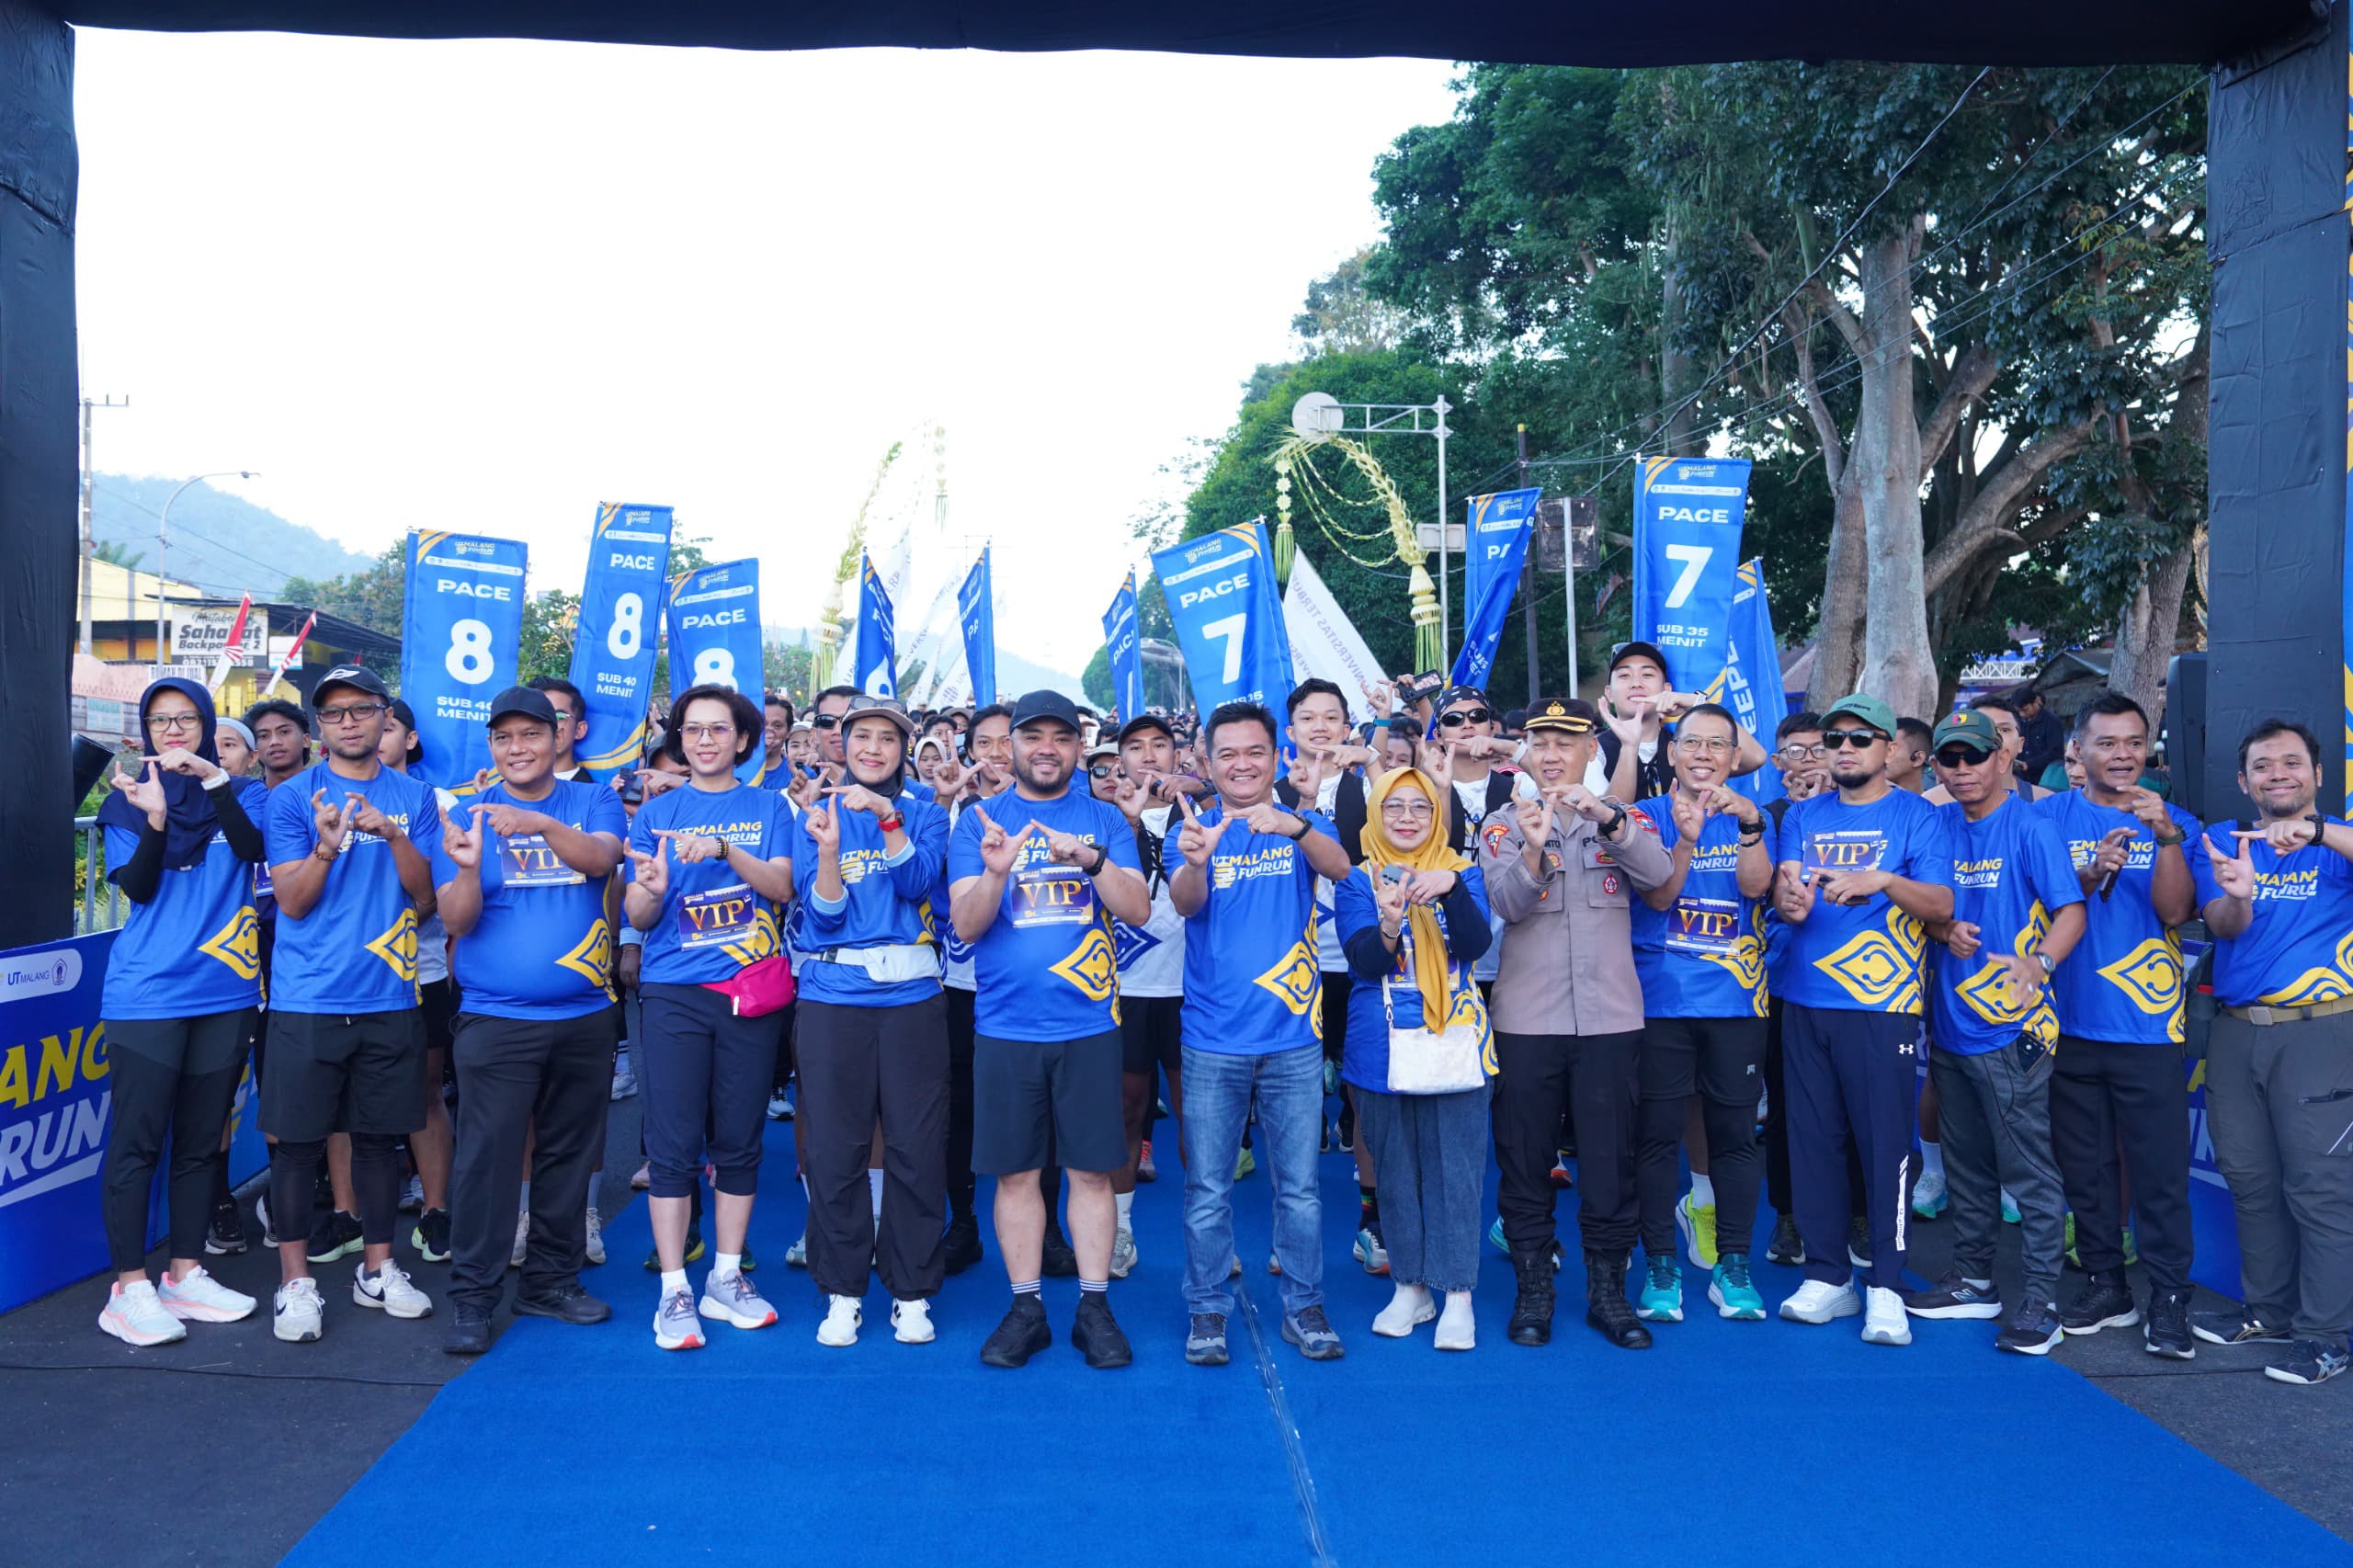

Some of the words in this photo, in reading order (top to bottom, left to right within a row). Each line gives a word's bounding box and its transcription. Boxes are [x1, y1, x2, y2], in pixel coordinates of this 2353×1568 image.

[1658, 506, 1729, 524] PACE
[609, 552, 655, 571] PACE
[1665, 543, 1713, 608] 7
[437, 578, 511, 601] PACE
[1179, 573, 1251, 608] PACE
[607, 592, 642, 660] 8
[681, 608, 746, 630] PACE
[1656, 624, 1684, 634] SUB
[1687, 627, 1709, 636] 35
[179, 624, 262, 639] Sahaat
[1656, 636, 1707, 647] MENIT
[445, 619, 494, 685] 8
[1113, 630, 1134, 666] PAC
[1201, 612, 1247, 685] 7
[597, 672, 622, 685] SUB
[623, 676, 637, 687] 40
[437, 696, 472, 708] SUB
[596, 685, 634, 699] MENIT
[1813, 843, 1870, 866] VIP
[1237, 858, 1292, 881] FUNRUN
[1018, 880, 1082, 908] VIP
[685, 899, 745, 931] VIP
[1677, 908, 1733, 937] VIP
